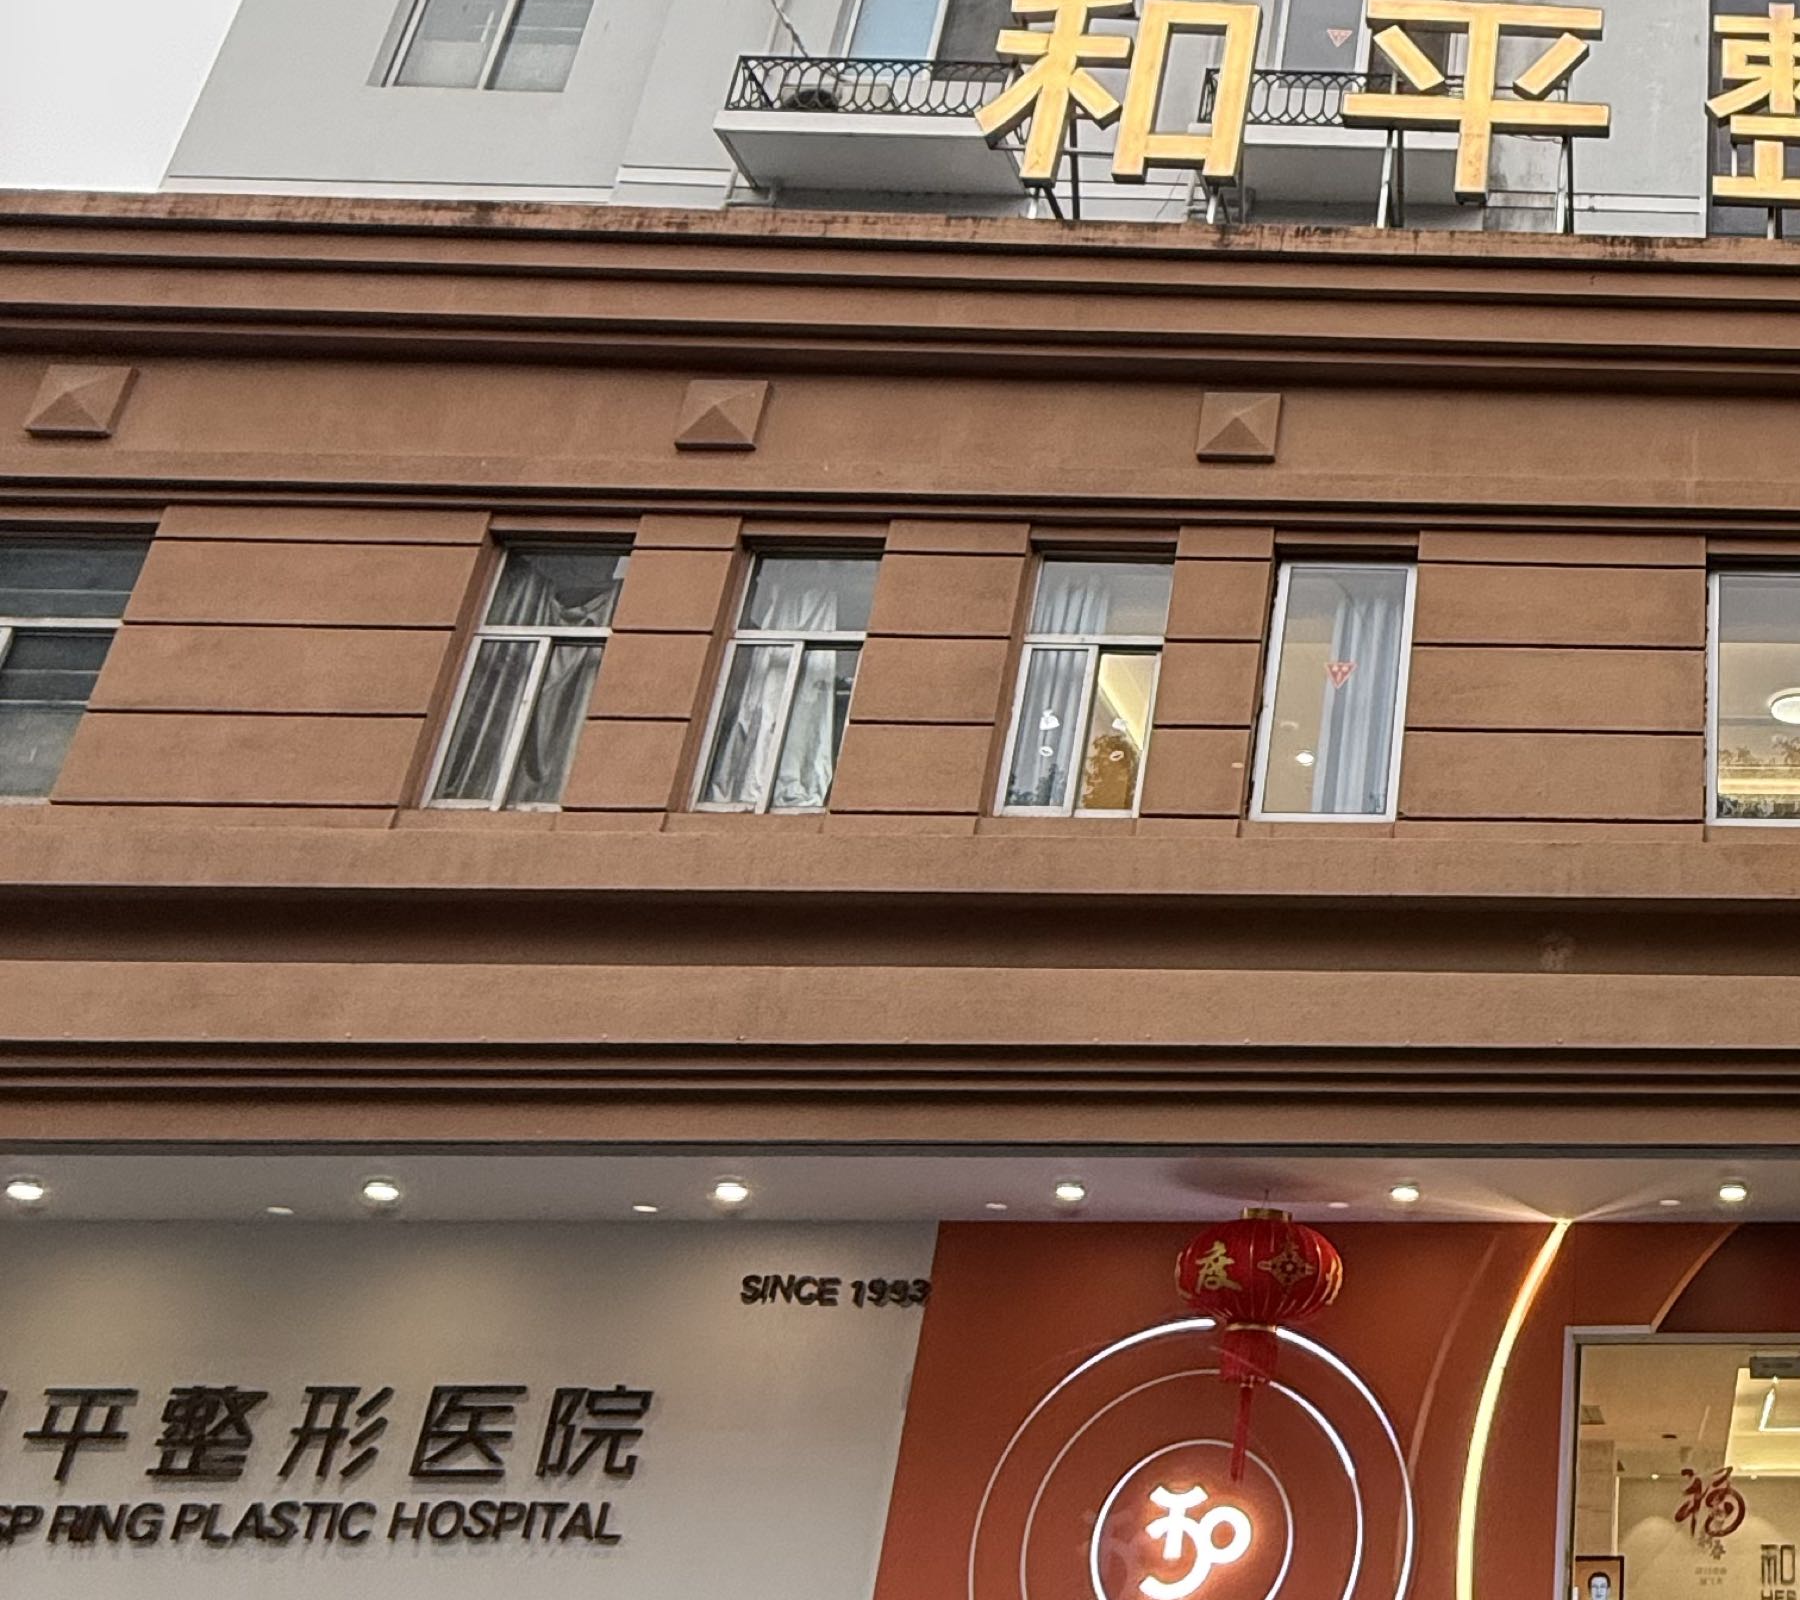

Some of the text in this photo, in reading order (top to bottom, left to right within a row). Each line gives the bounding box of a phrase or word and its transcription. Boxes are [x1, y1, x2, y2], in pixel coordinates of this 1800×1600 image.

[740, 1274, 932, 1308] SINCE 1993
[0, 1384, 654, 1482] 平整形医院
[169, 1501, 376, 1546] PLASTIC
[387, 1500, 622, 1545] HOSPITAL
